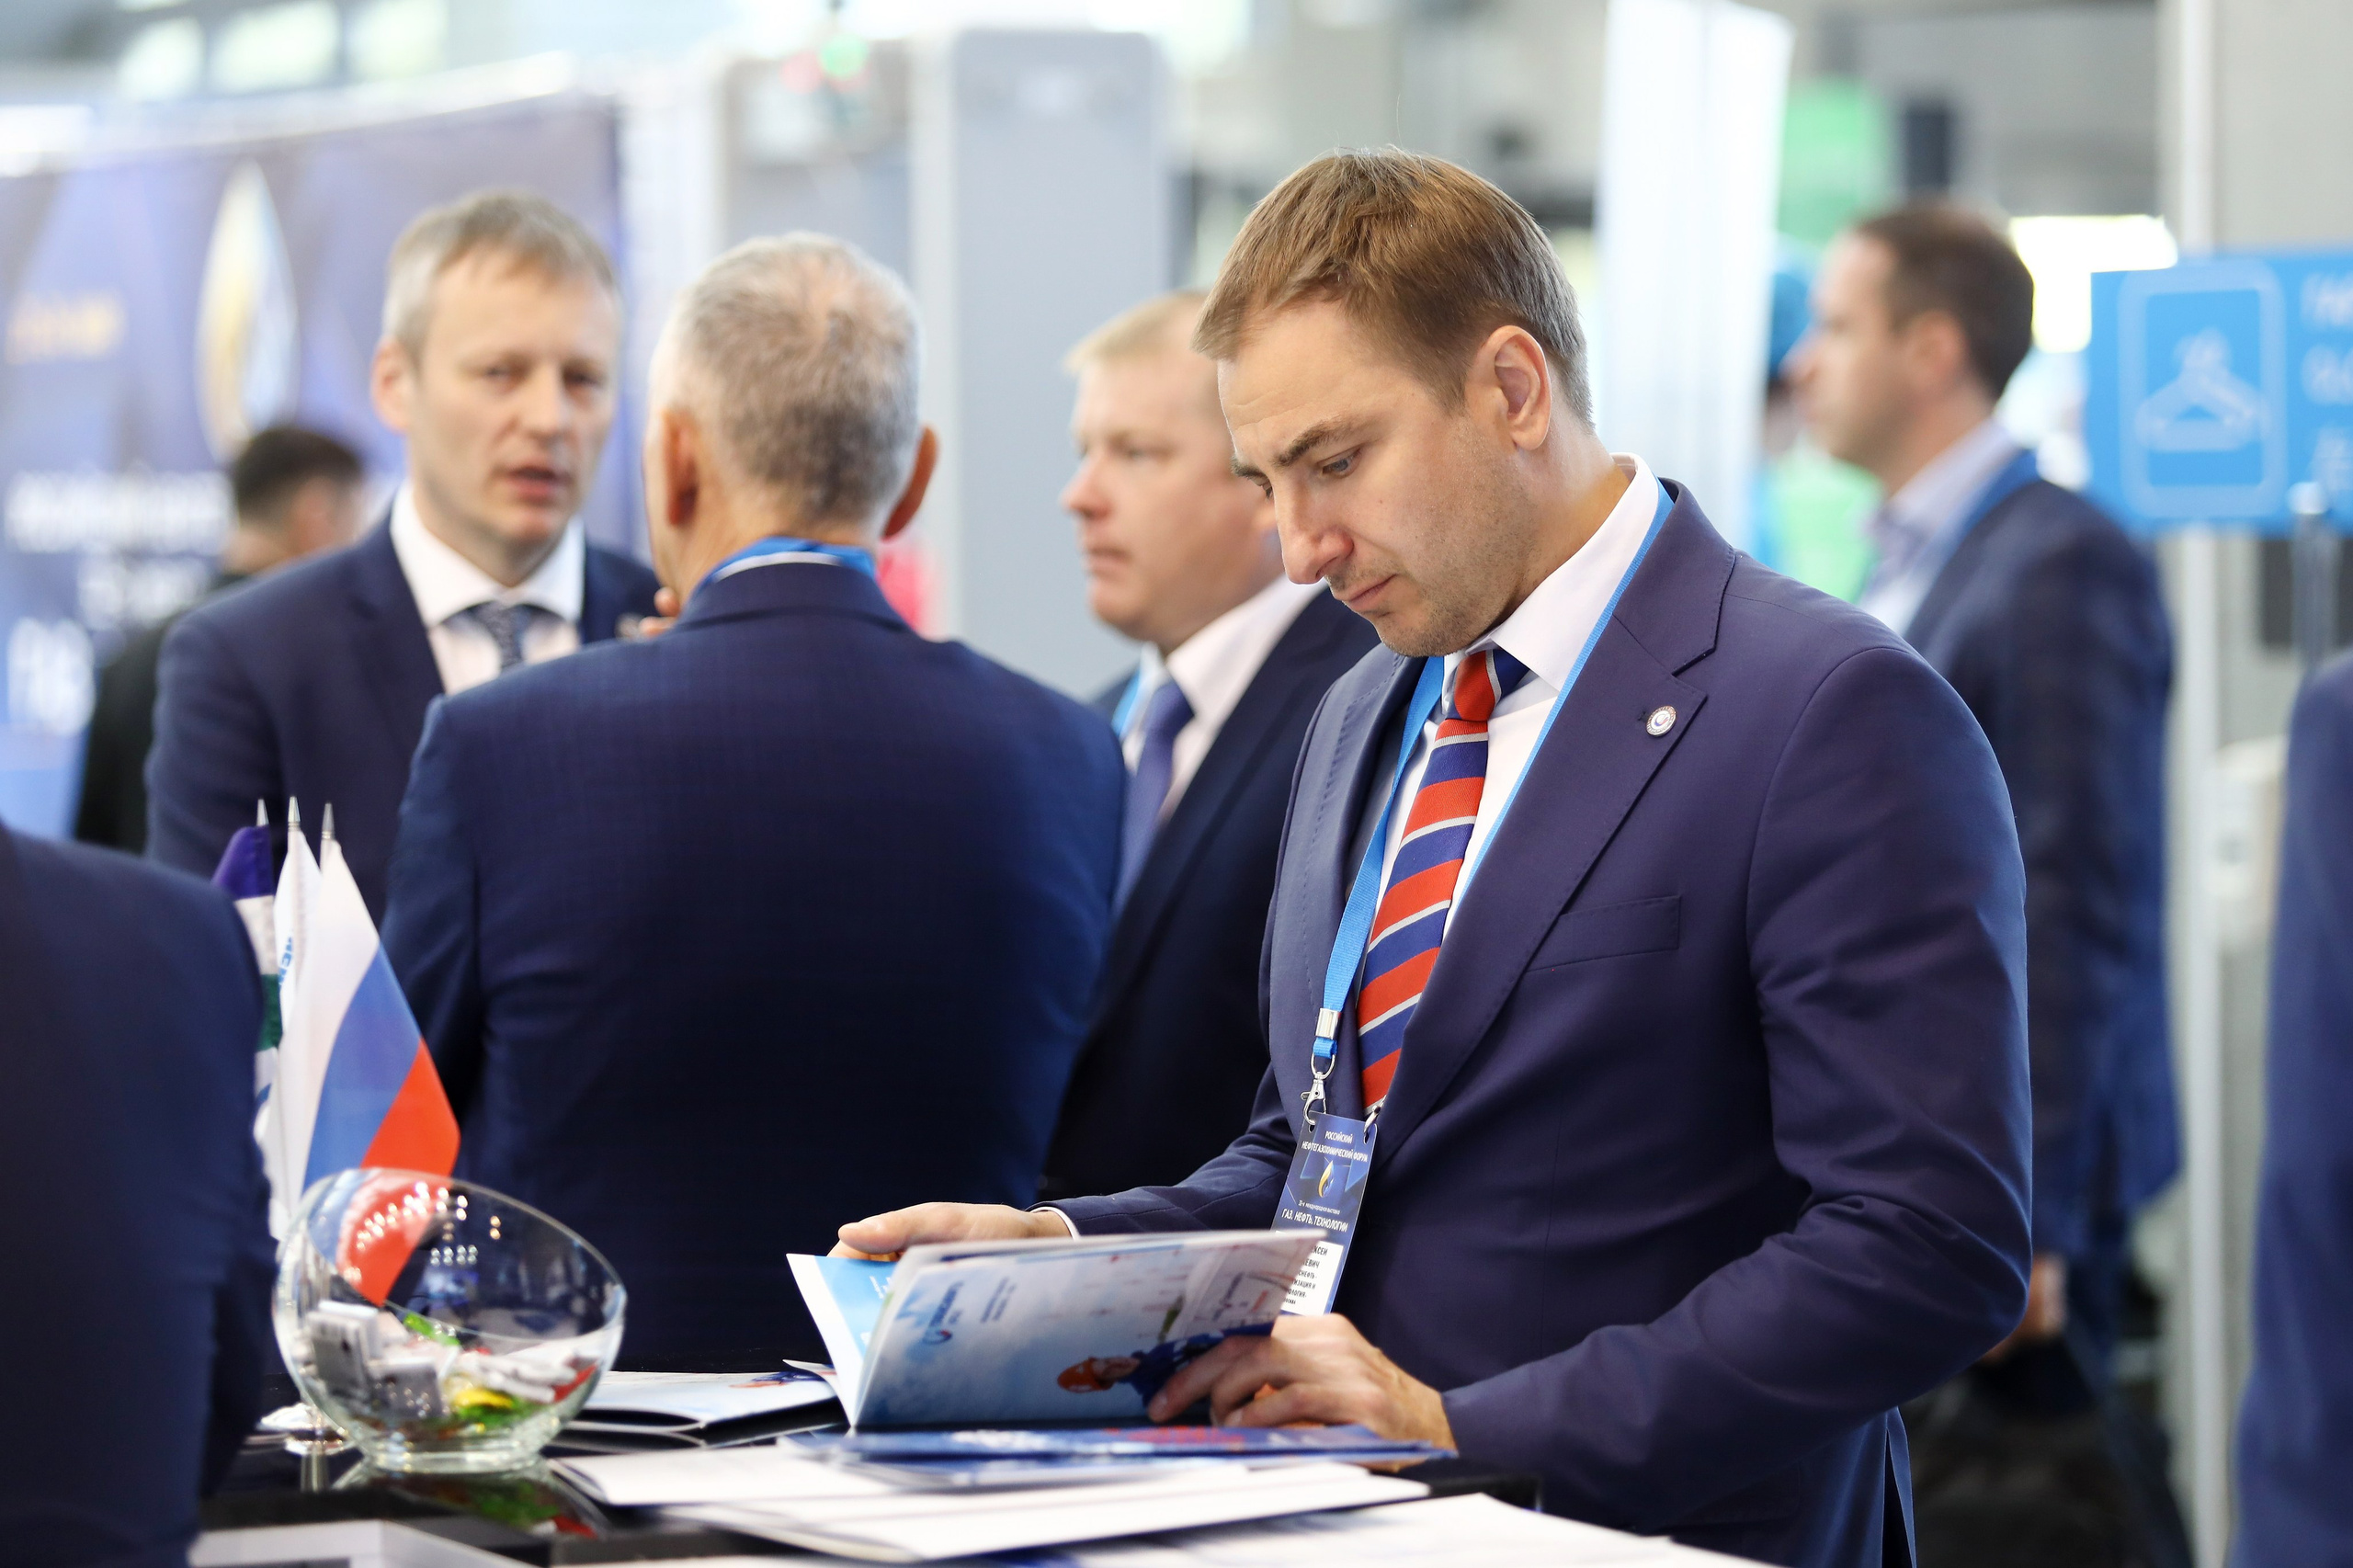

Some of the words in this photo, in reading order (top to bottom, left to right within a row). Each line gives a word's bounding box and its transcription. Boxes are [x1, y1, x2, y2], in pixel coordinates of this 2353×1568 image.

[1324, 1131, 1353, 1143] РОССИЙСКИЙ
[1302, 1141, 1353, 1159] НЕФТЕГАЗОХИМИЧЕСКИЙ
[1353, 1152, 1368, 1163] ФОРУМ
[1281, 1209, 1292, 1220] ГАЗ.
[1294, 1211, 1313, 1224] НЕФТЬ.
[1313, 1216, 1348, 1233] ТЕХНОЛОГИИ
[1303, 1258, 1320, 1268] ЕВИЧ
[1298, 1269, 1314, 1278] СНЕФТЬ
[1292, 1279, 1311, 1290] ИЗАЦИЯ
